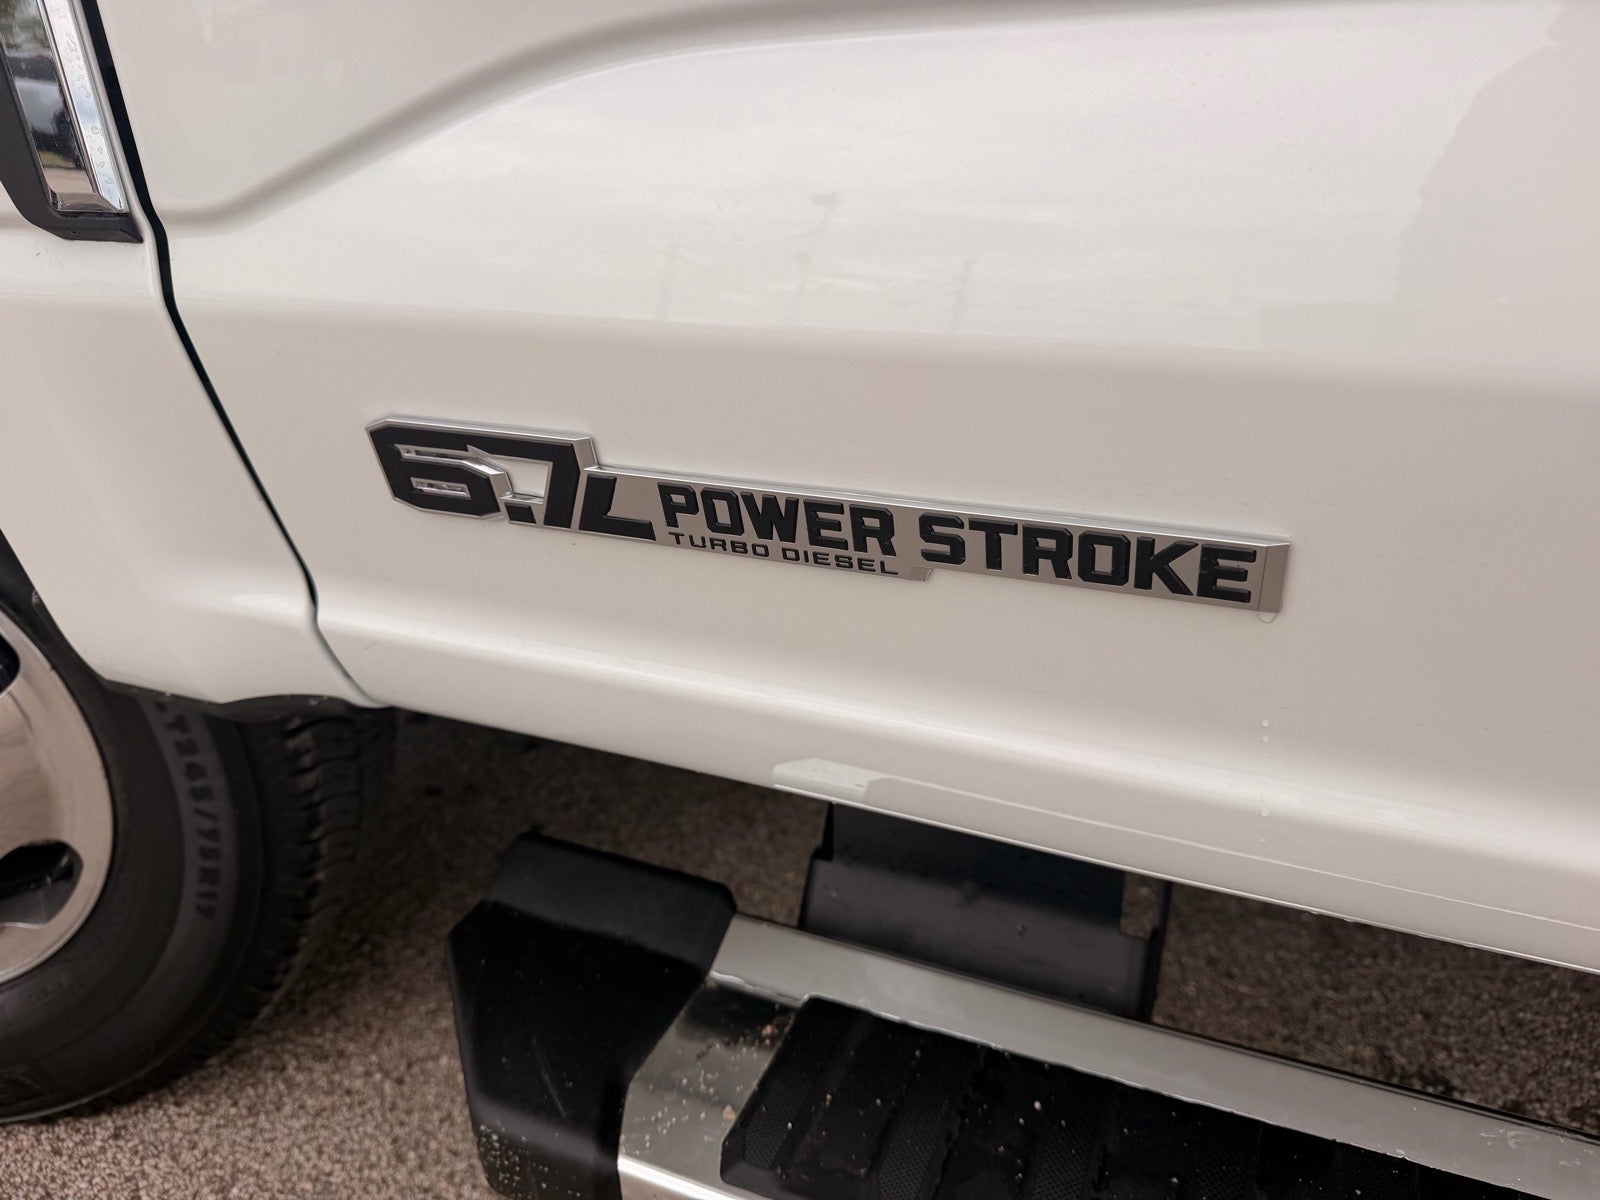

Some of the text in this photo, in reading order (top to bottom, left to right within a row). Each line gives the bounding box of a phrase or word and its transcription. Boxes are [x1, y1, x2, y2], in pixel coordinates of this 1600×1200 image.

[368, 424, 1257, 604] 6.7L POWER STROKE
[668, 531, 899, 576] TURBO DIESEL
